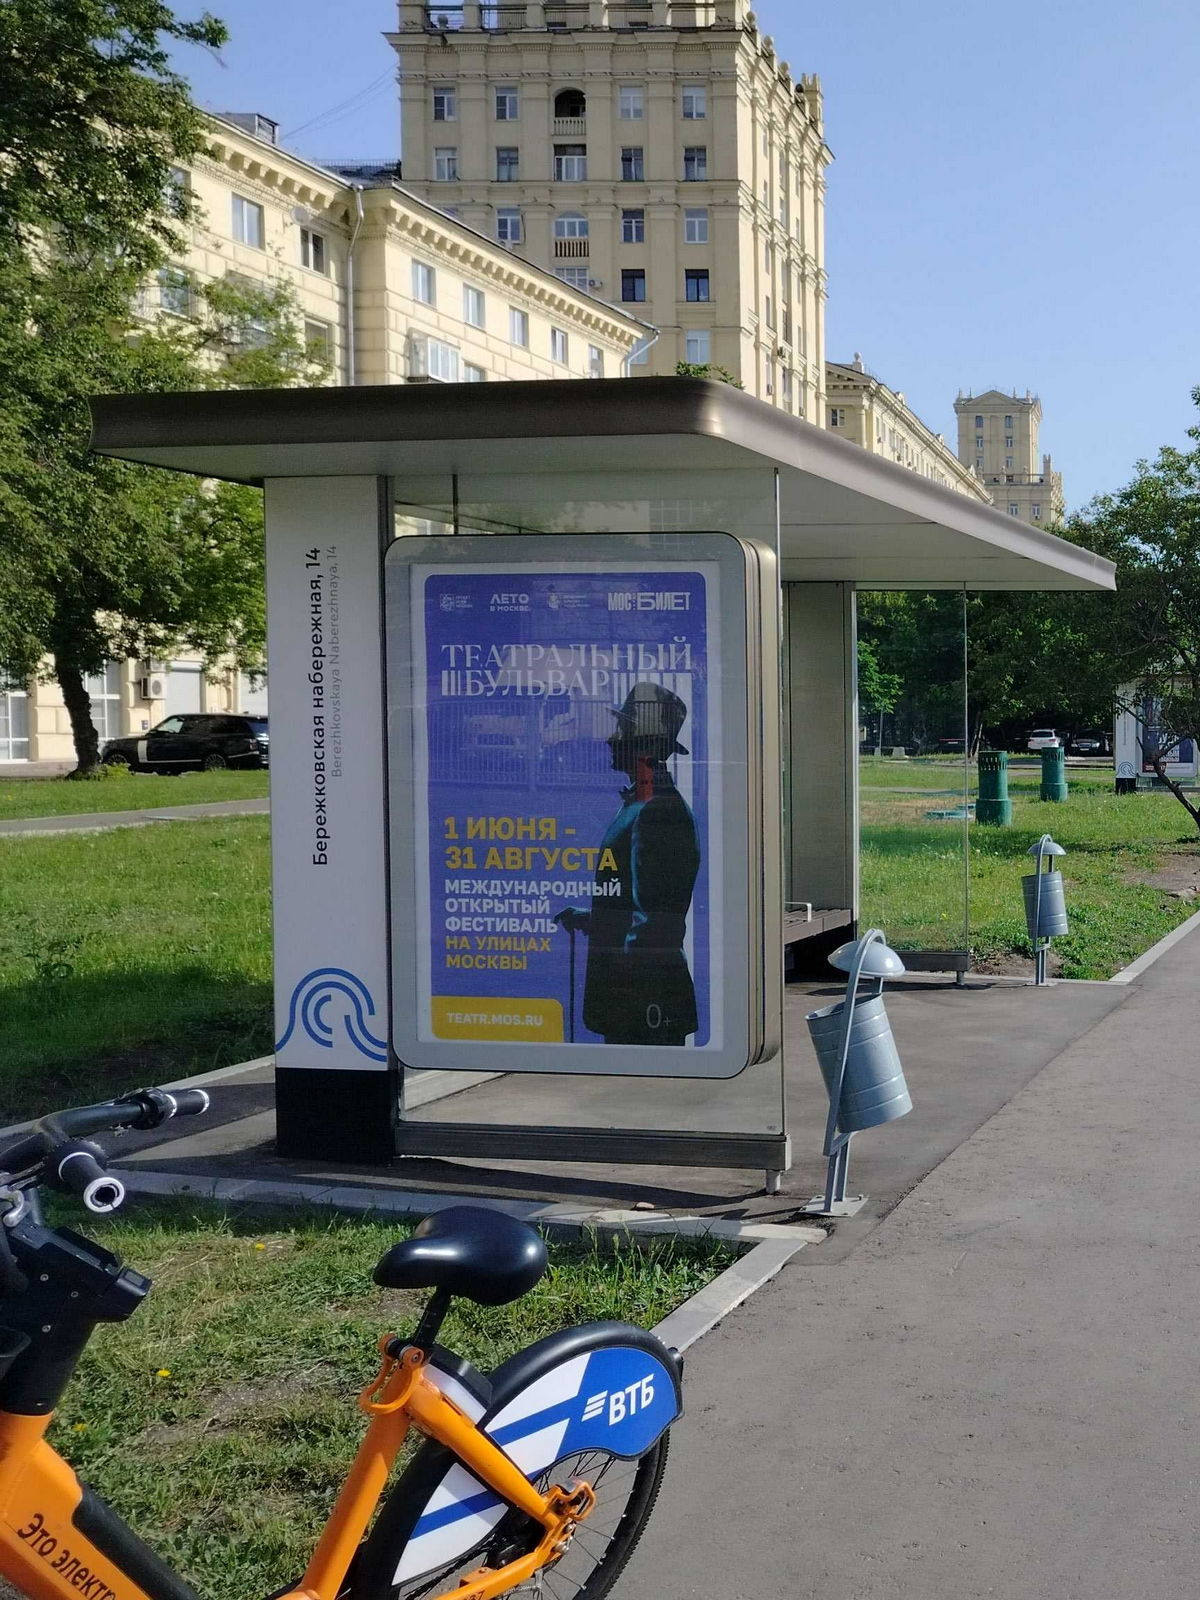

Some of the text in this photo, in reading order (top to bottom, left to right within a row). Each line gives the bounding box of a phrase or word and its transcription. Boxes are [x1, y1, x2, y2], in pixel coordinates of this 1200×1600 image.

[489, 593, 530, 605] ЛЕТО
[326, 545, 343, 778] Berezhkovskaya Naberezhnaya, 14
[441, 636, 692, 670] ТЕАТРАЛЬНЫЙ
[466, 670, 609, 697] БУЛЬВАР
[305, 547, 330, 866] Бережковская набережная, 14
[444, 816, 459, 840] 1
[467, 816, 557, 841] ИЮНЯ
[445, 845, 619, 872] 31 АВГУСТА
[444, 877, 622, 899] МЕЖДУНАРОДНЫЙ
[444, 895, 550, 915] ОТКРЫТЫЙ
[445, 915, 558, 934] ФЕСТИВАЛЬ
[446, 936, 552, 953] НА УЛИЦАХ
[446, 954, 528, 971] МОСКВЫ
[446, 1012, 544, 1027] TEATR.MOS.RU
[646, 1003, 672, 1029] 0+
[608, 1373, 655, 1427] ВТБ
[17, 1512, 58, 1557] Это
